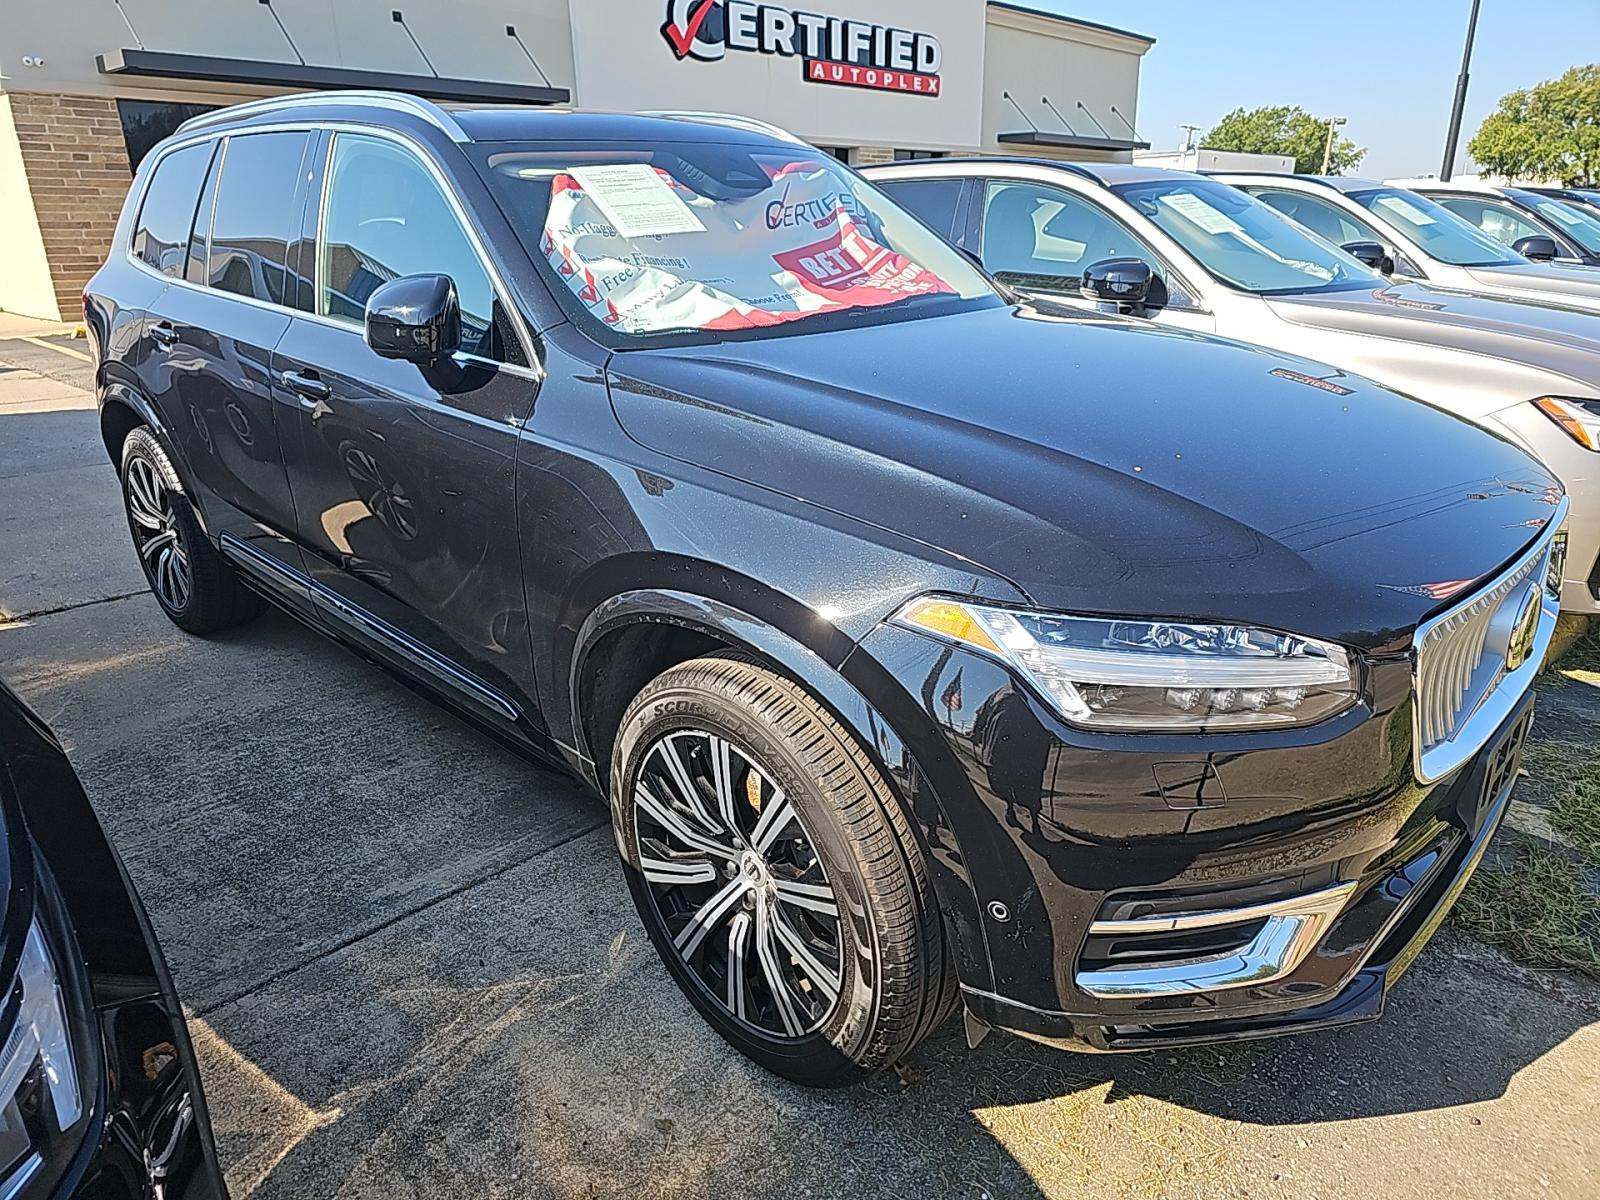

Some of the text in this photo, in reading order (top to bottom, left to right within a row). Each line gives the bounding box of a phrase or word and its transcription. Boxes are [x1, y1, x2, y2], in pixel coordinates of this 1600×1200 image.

[668, 0, 943, 74] CERTIFIED
[812, 62, 939, 93] AUTOPLEX
[766, 192, 867, 230] CERTIFED
[601, 268, 634, 292] Free
